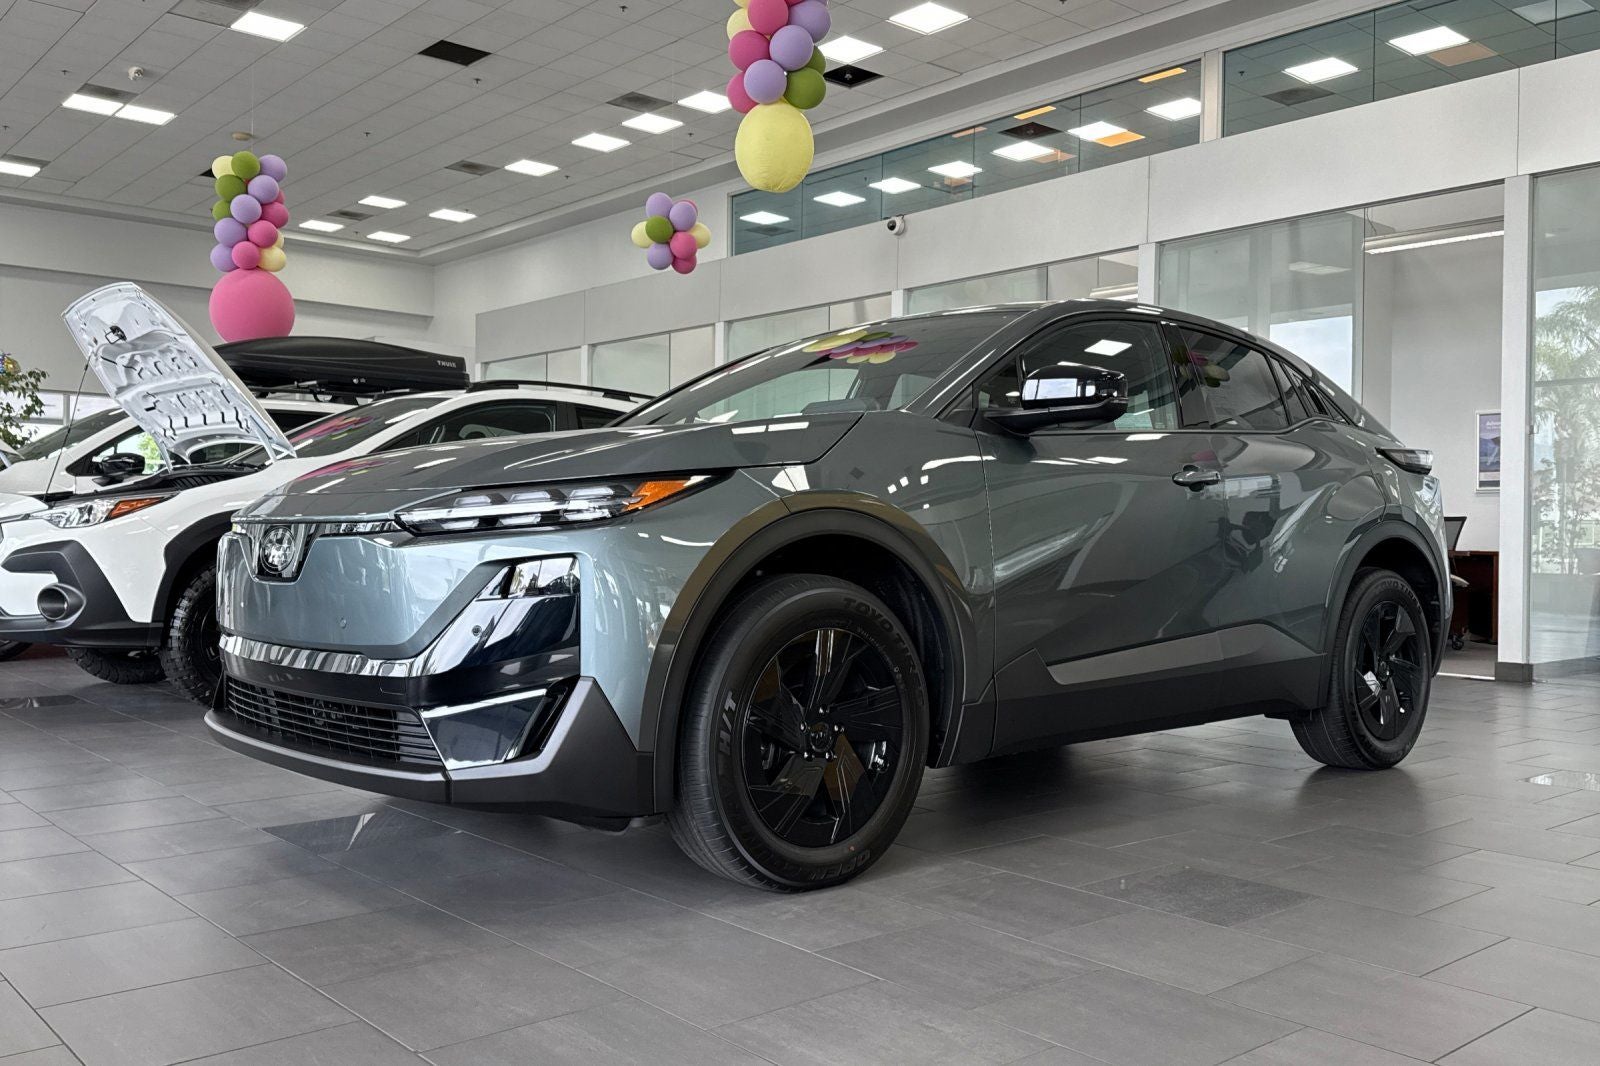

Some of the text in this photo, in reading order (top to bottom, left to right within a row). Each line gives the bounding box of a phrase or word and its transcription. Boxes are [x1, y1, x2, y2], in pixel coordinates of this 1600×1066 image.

[437, 360, 456, 368] THULE
[843, 596, 894, 633] TOYO
[719, 690, 737, 756] H/T
